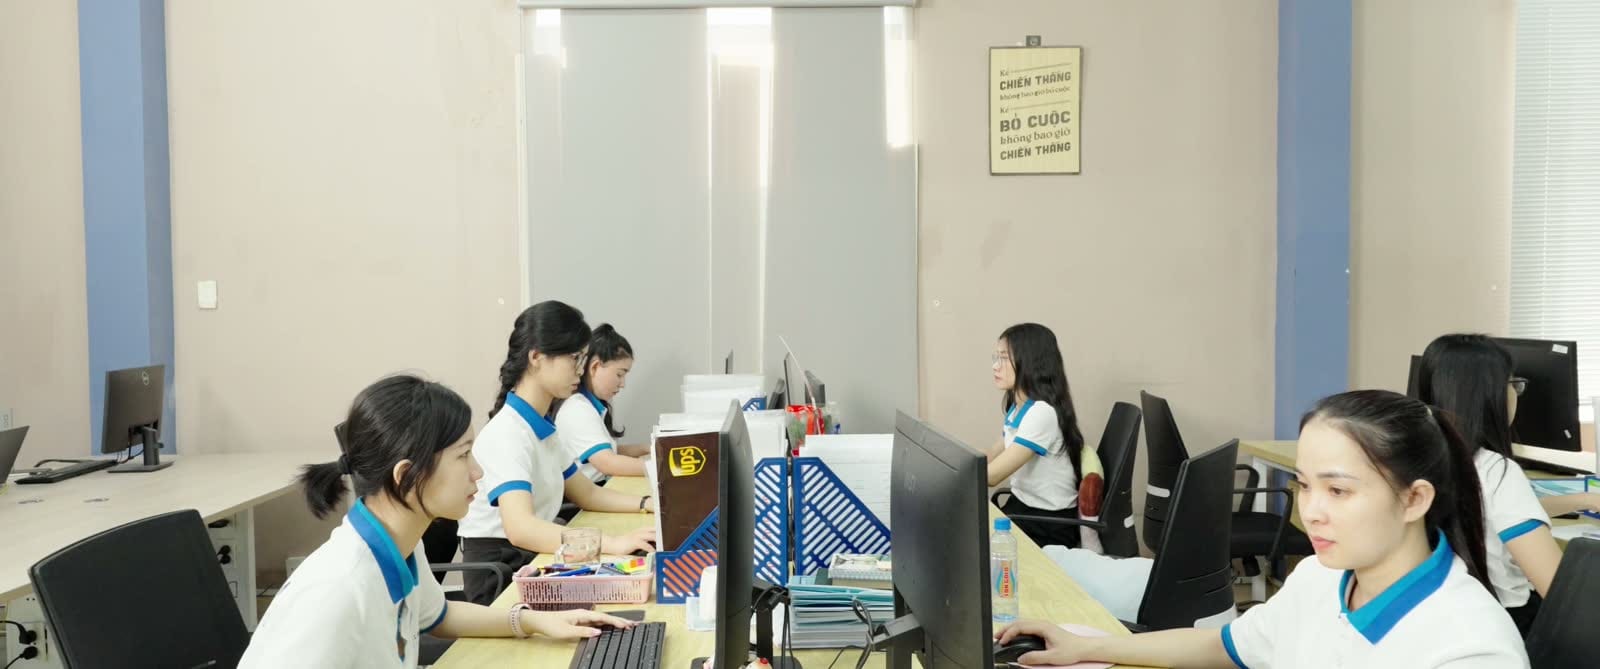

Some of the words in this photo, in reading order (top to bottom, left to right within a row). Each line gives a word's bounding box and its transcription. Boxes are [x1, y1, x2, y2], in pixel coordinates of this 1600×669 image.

[1000, 75, 1031, 90] CHIẾN
[1035, 71, 1071, 85] THẮNG
[1000, 113, 1021, 132] BỎ
[1028, 110, 1071, 128] CUỘC
[1000, 134, 1031, 145] không
[1034, 131, 1052, 141] bao
[1054, 127, 1071, 139] giờ
[1000, 145, 1031, 160] CHIẾN
[1035, 141, 1071, 155] THẮNG
